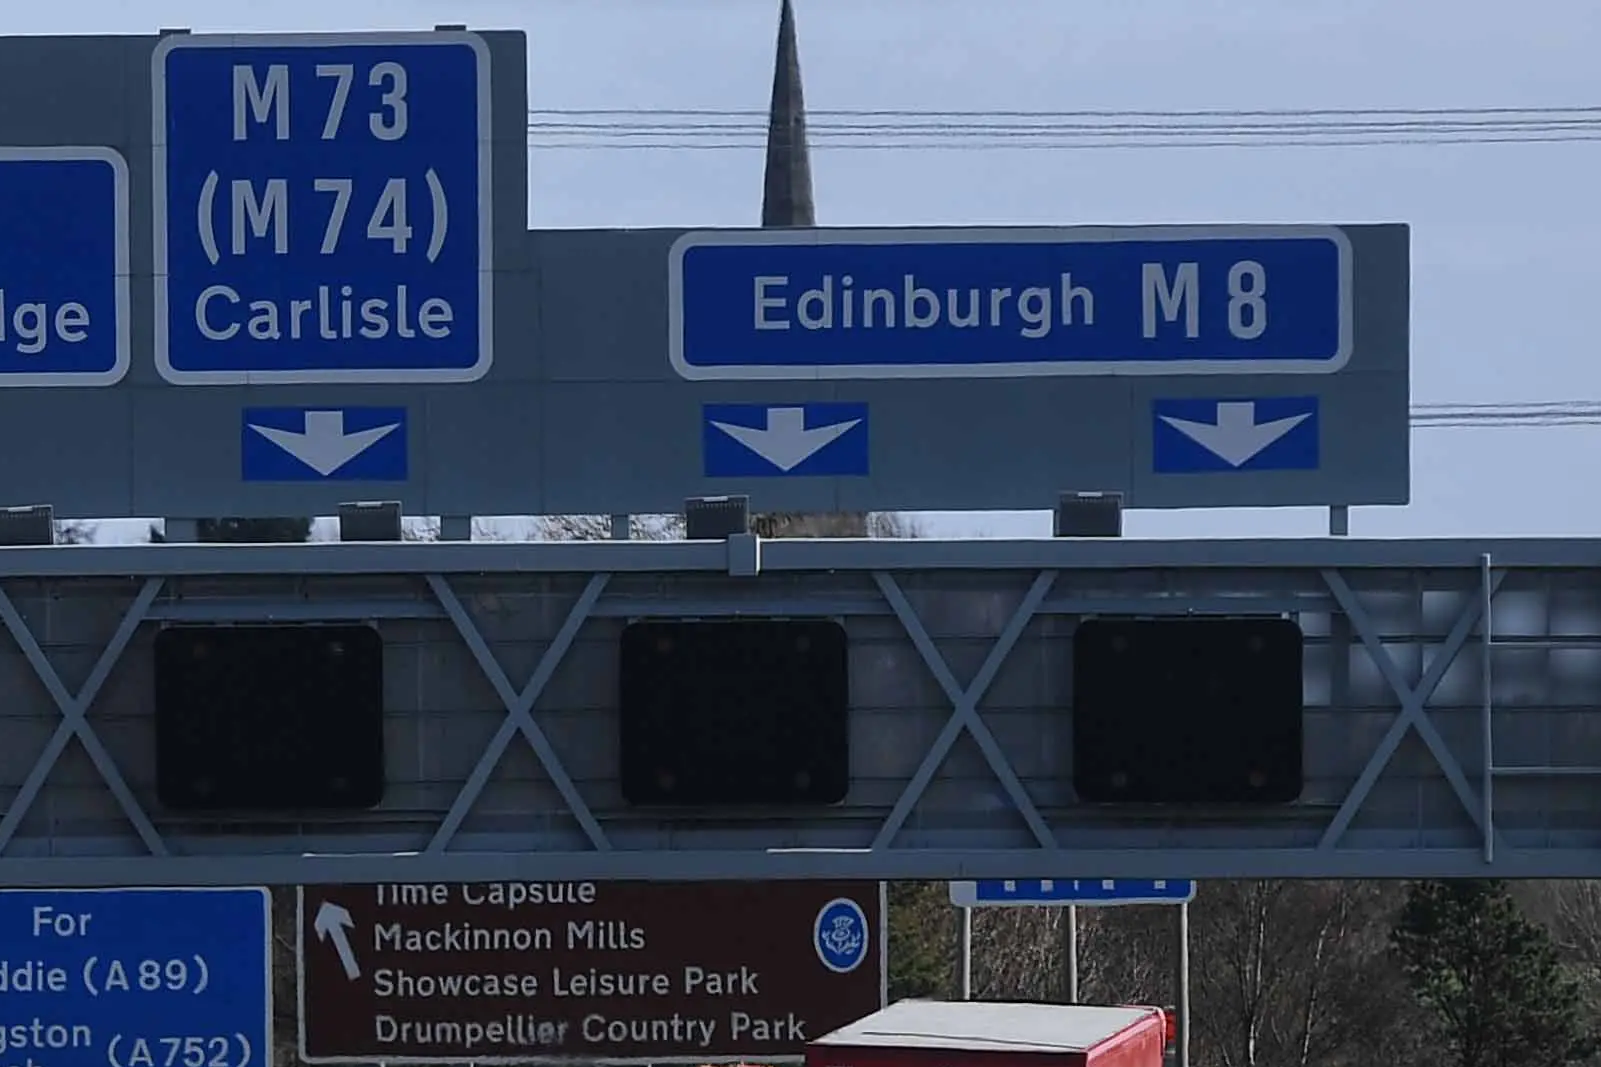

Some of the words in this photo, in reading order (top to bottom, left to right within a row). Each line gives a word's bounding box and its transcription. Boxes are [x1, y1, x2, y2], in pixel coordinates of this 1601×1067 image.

[196, 285, 453, 340] Carlisle
[754, 273, 1093, 338] Edinburgh
[34, 907, 91, 936] For
[375, 923, 551, 950] Mackinnon
[568, 921, 644, 949] Mills
[375, 969, 537, 996] Showcase
[554, 968, 669, 995] Leisure
[686, 966, 758, 994] Park
[376, 1014, 569, 1046] Drumpellier
[582, 1013, 716, 1044] Country
[730, 1007, 806, 1041] Park
